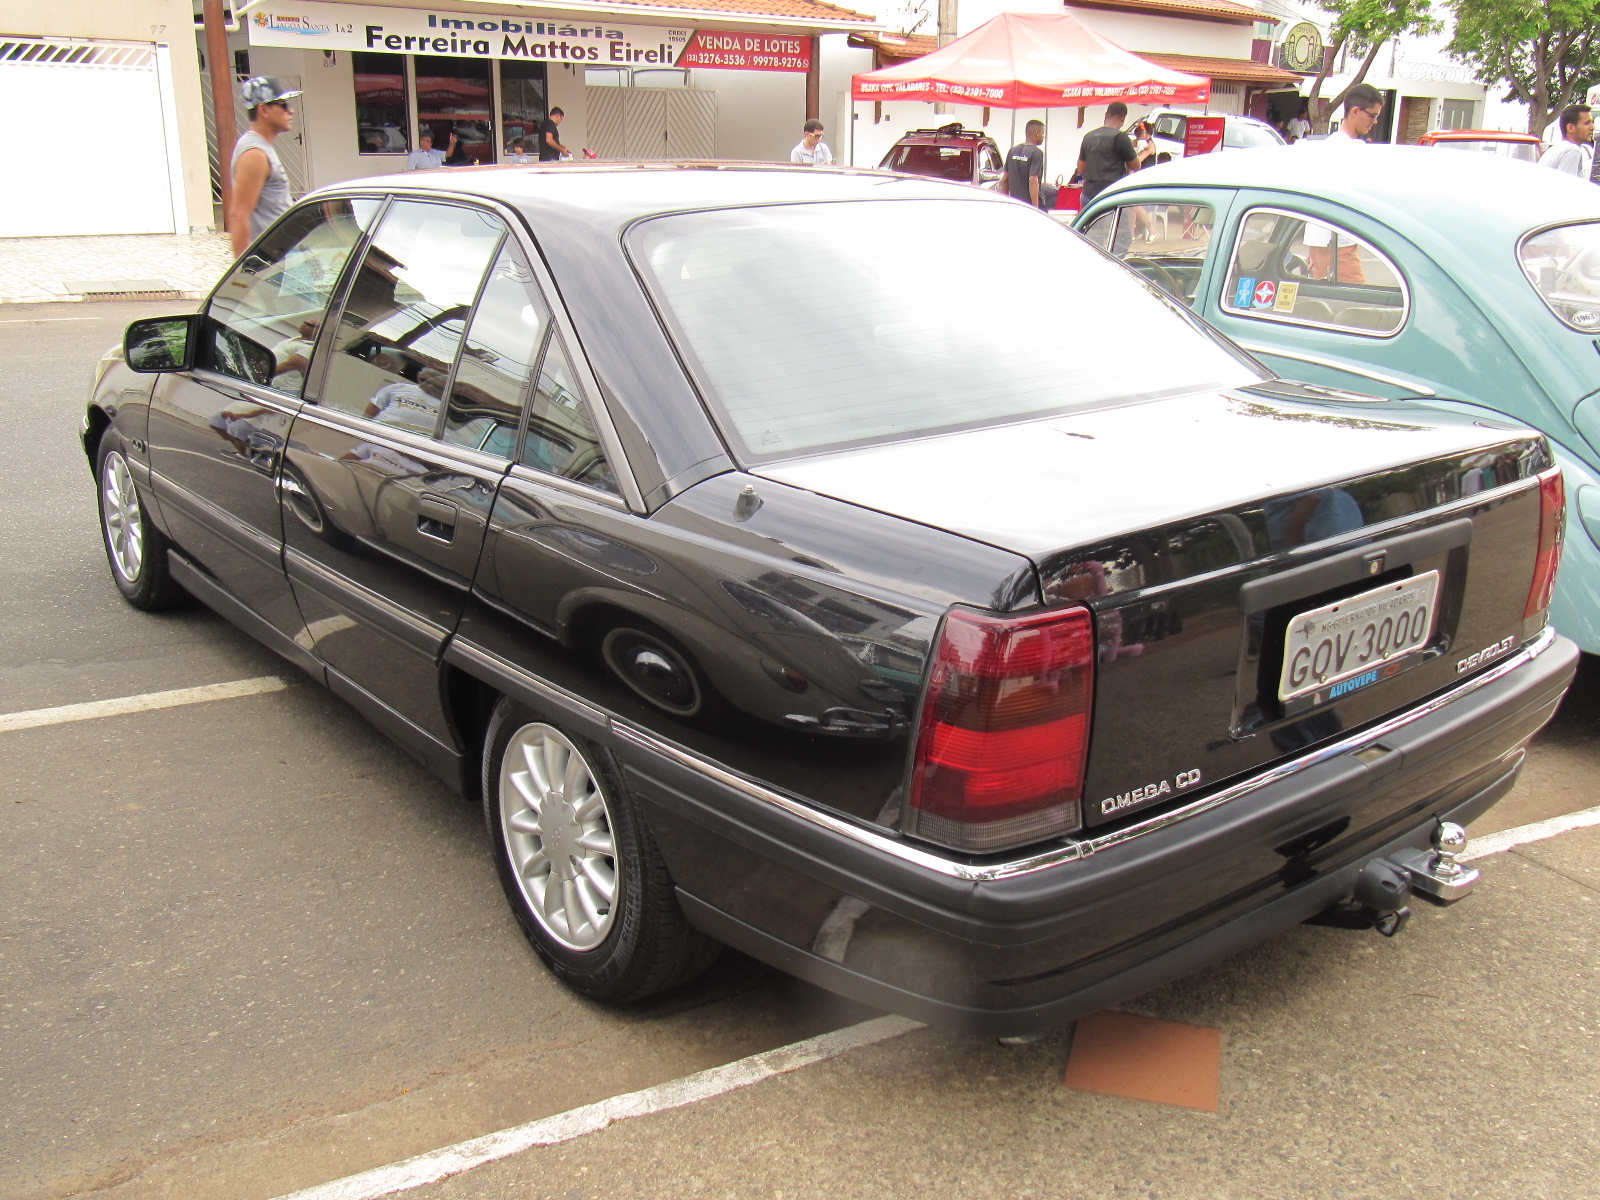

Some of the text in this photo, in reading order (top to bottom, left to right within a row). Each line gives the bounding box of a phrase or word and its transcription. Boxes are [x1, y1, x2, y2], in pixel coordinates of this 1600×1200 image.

[150, 24, 167, 34] 77
[269, 13, 301, 29] LAGOA
[302, 15, 330, 32] SANTA
[427, 14, 625, 40] Imobiliária
[366, 25, 674, 64] Ferreira Mattos Eireli
[697, 35, 801, 54] VENDA DE LOTES
[753, 55, 802, 68] 99978-9276
[860, 83, 880, 93] OSAKA
[895, 82, 930, 92] VALADARES
[950, 84, 965, 95] (33)
[966, 86, 1005, 99] 2101-7000
[1456, 635, 1514, 673] CHEVROLET
[1329, 670, 1378, 699] AUTOVEPE
[1101, 768, 1201, 814] OMEGA CD
